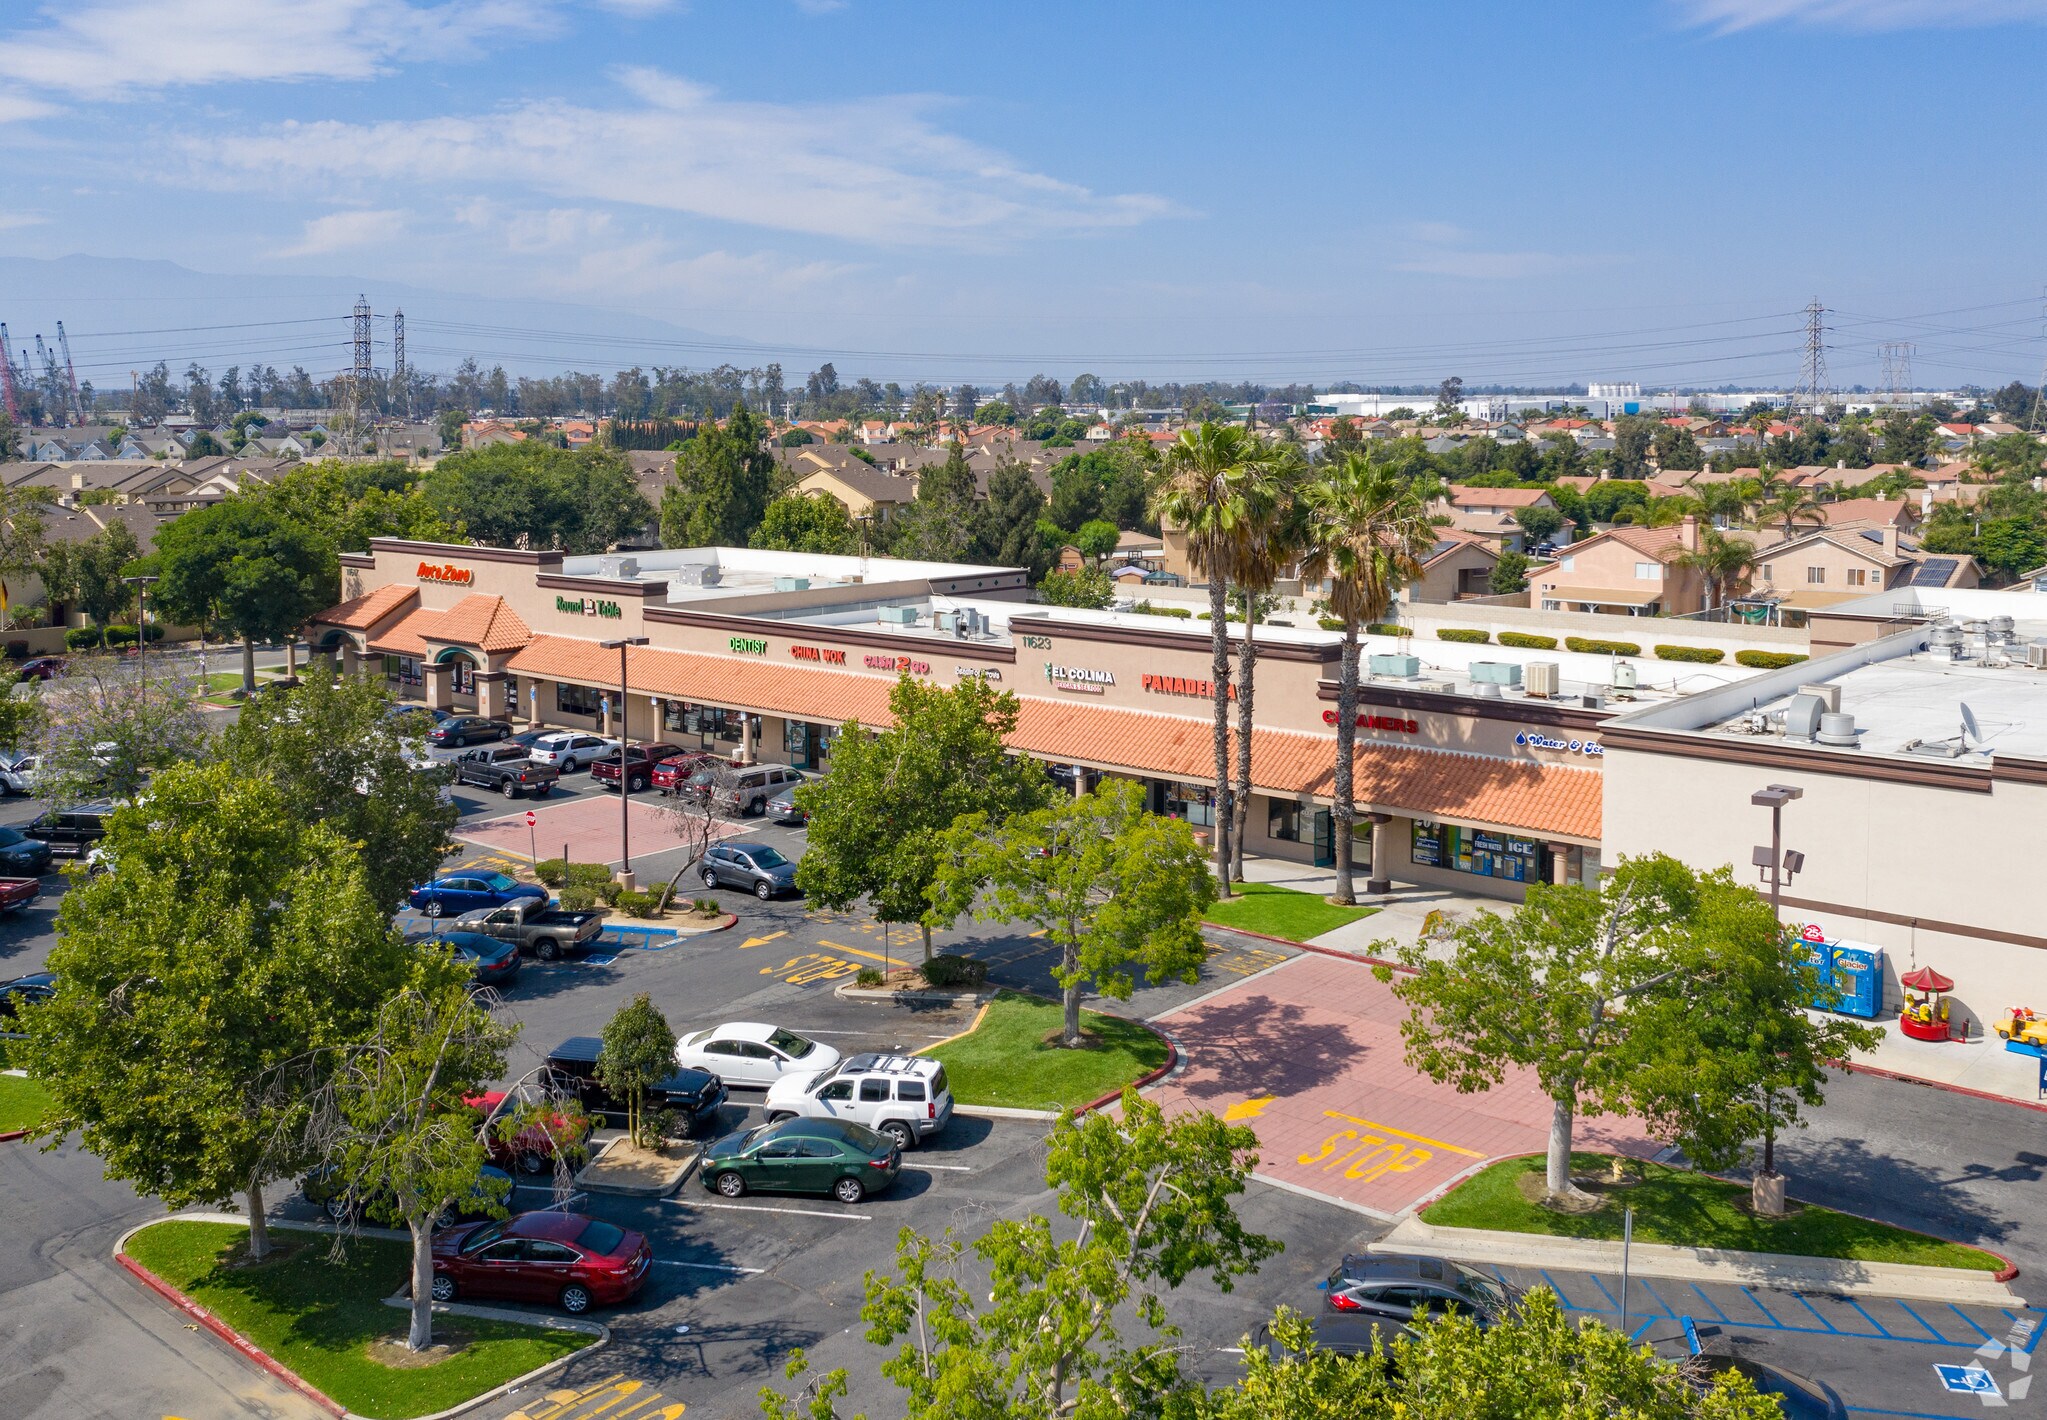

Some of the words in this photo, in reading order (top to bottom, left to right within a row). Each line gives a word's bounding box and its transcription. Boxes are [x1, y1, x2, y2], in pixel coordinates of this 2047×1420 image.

[416, 561, 471, 583] AutoZone
[556, 595, 583, 613] Round
[596, 599, 621, 616] Table
[729, 637, 766, 654] DENTIST
[1023, 636, 1052, 650] 11623
[790, 645, 819, 660] CHINA
[822, 648, 845, 663] WOK
[863, 655, 893, 669] CASH
[896, 656, 910, 670] 2
[911, 661, 929, 673] GO
[1052, 667, 1067, 678] EL
[1069, 669, 1114, 683] COLIMA
[1141, 673, 1236, 700] PANADERA
[1322, 709, 1419, 734] CANERS
[1528, 733, 1566, 748] Water
[1569, 740, 1580, 750] &
[1584, 742, 1604, 753] Ice
[1474, 840, 1488, 849] FRESH
[1488, 843, 1502, 852] WATER
[1508, 841, 1533, 855] ICE
[759, 953, 863, 986] STOP
[1838, 958, 1868, 970] Glacier
[1297, 1129, 1433, 1183] STOP
